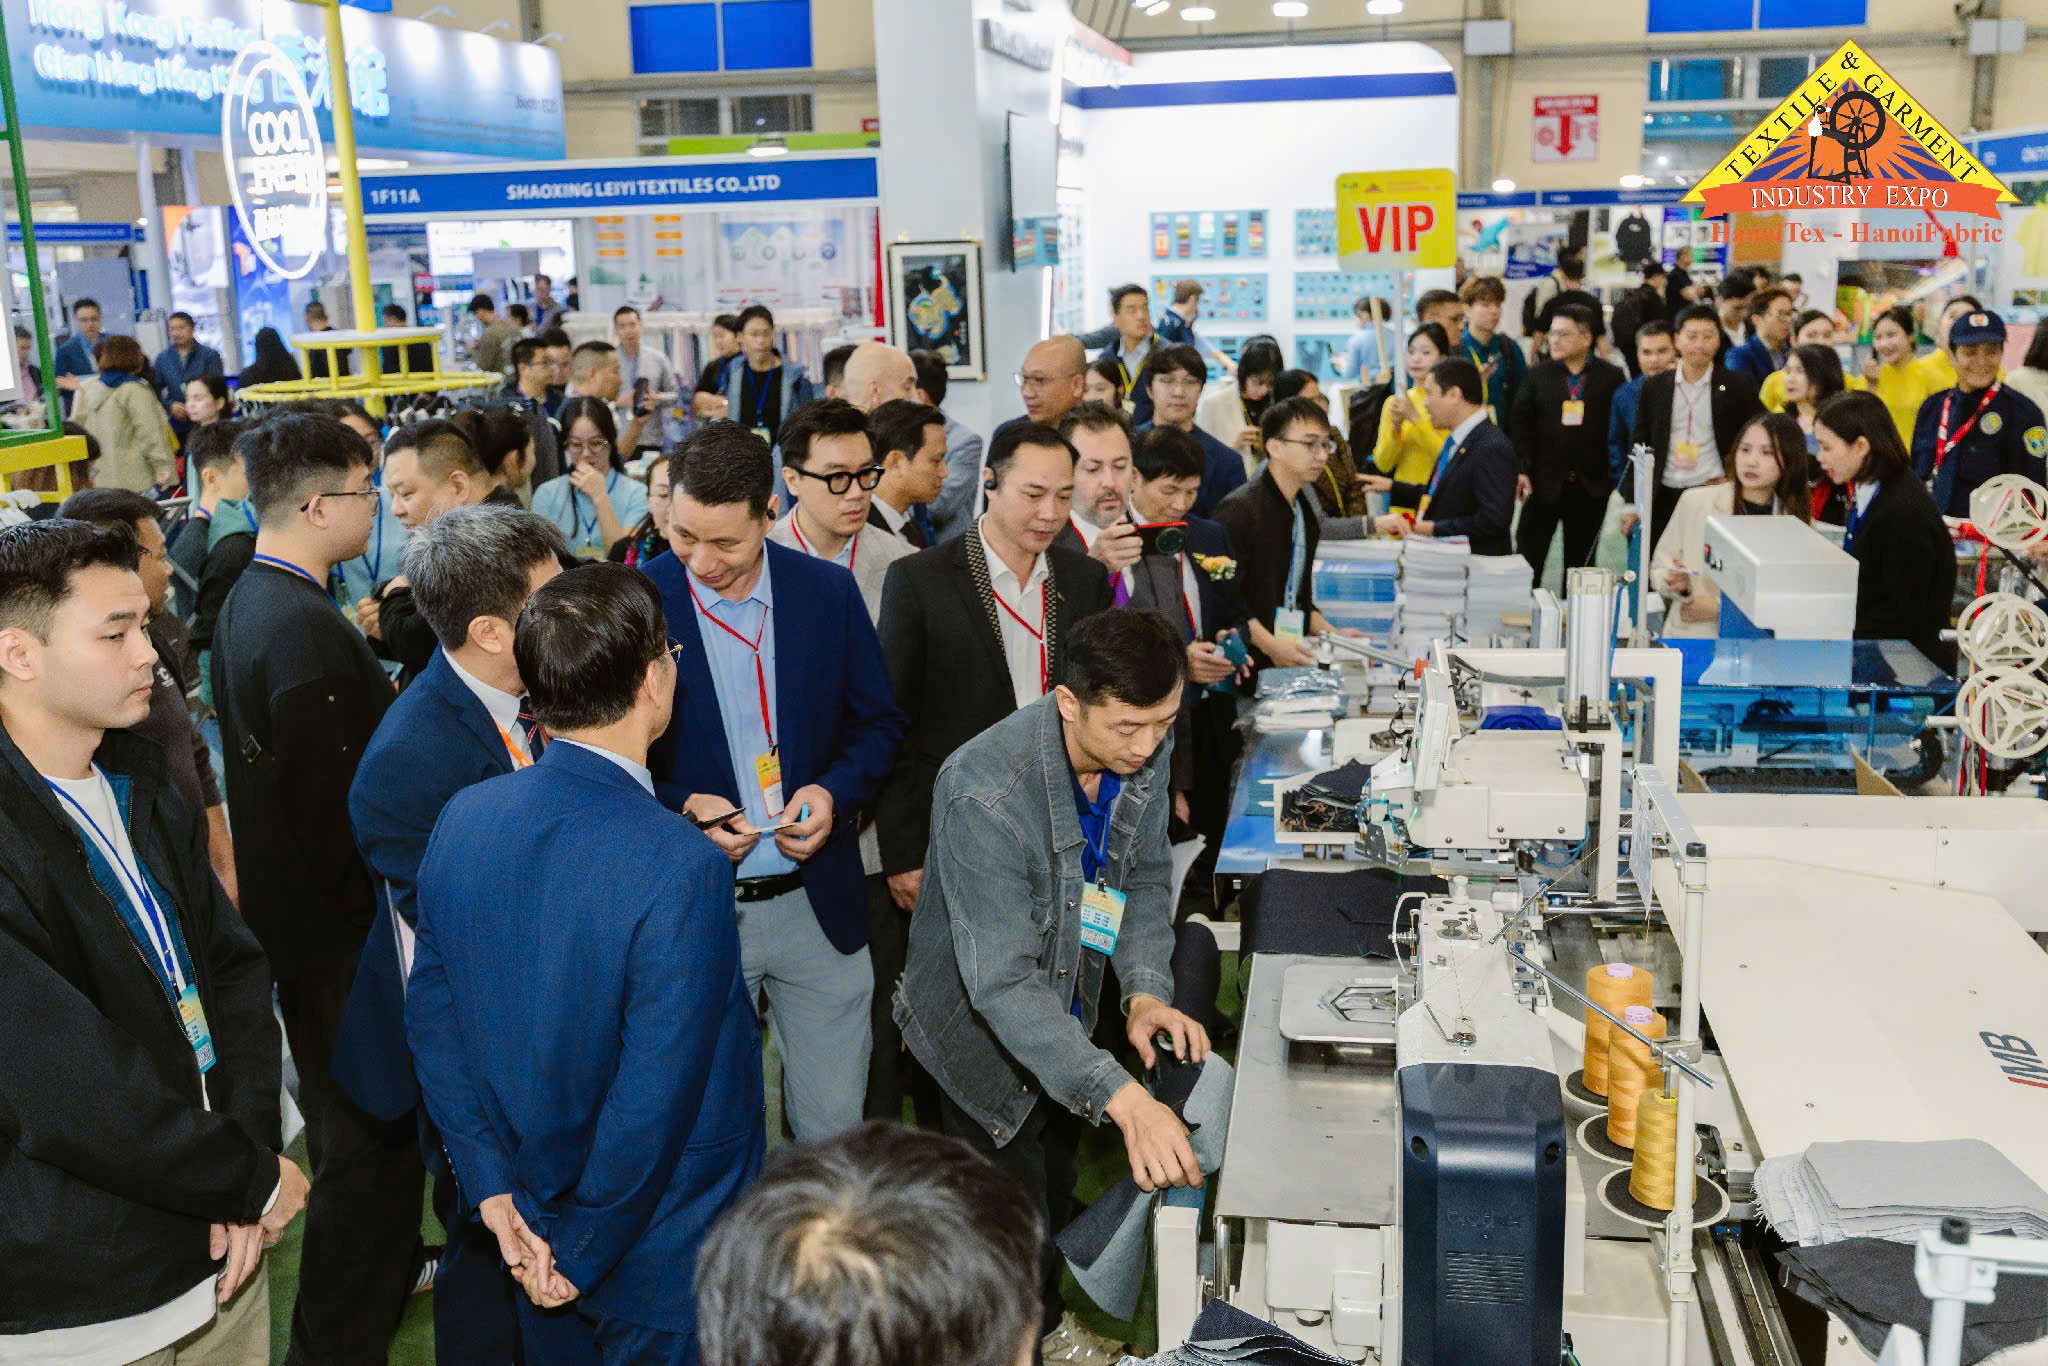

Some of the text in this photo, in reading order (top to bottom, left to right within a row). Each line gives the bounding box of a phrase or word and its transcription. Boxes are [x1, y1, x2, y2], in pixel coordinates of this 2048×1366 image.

[247, 109, 310, 155] COOL
[370, 188, 421, 205] 1F11A
[506, 182, 594, 200] SHAOXING
[595, 180, 636, 197] LEIYI
[637, 177, 714, 195] TEXTILES
[1356, 204, 1434, 253] VIP
